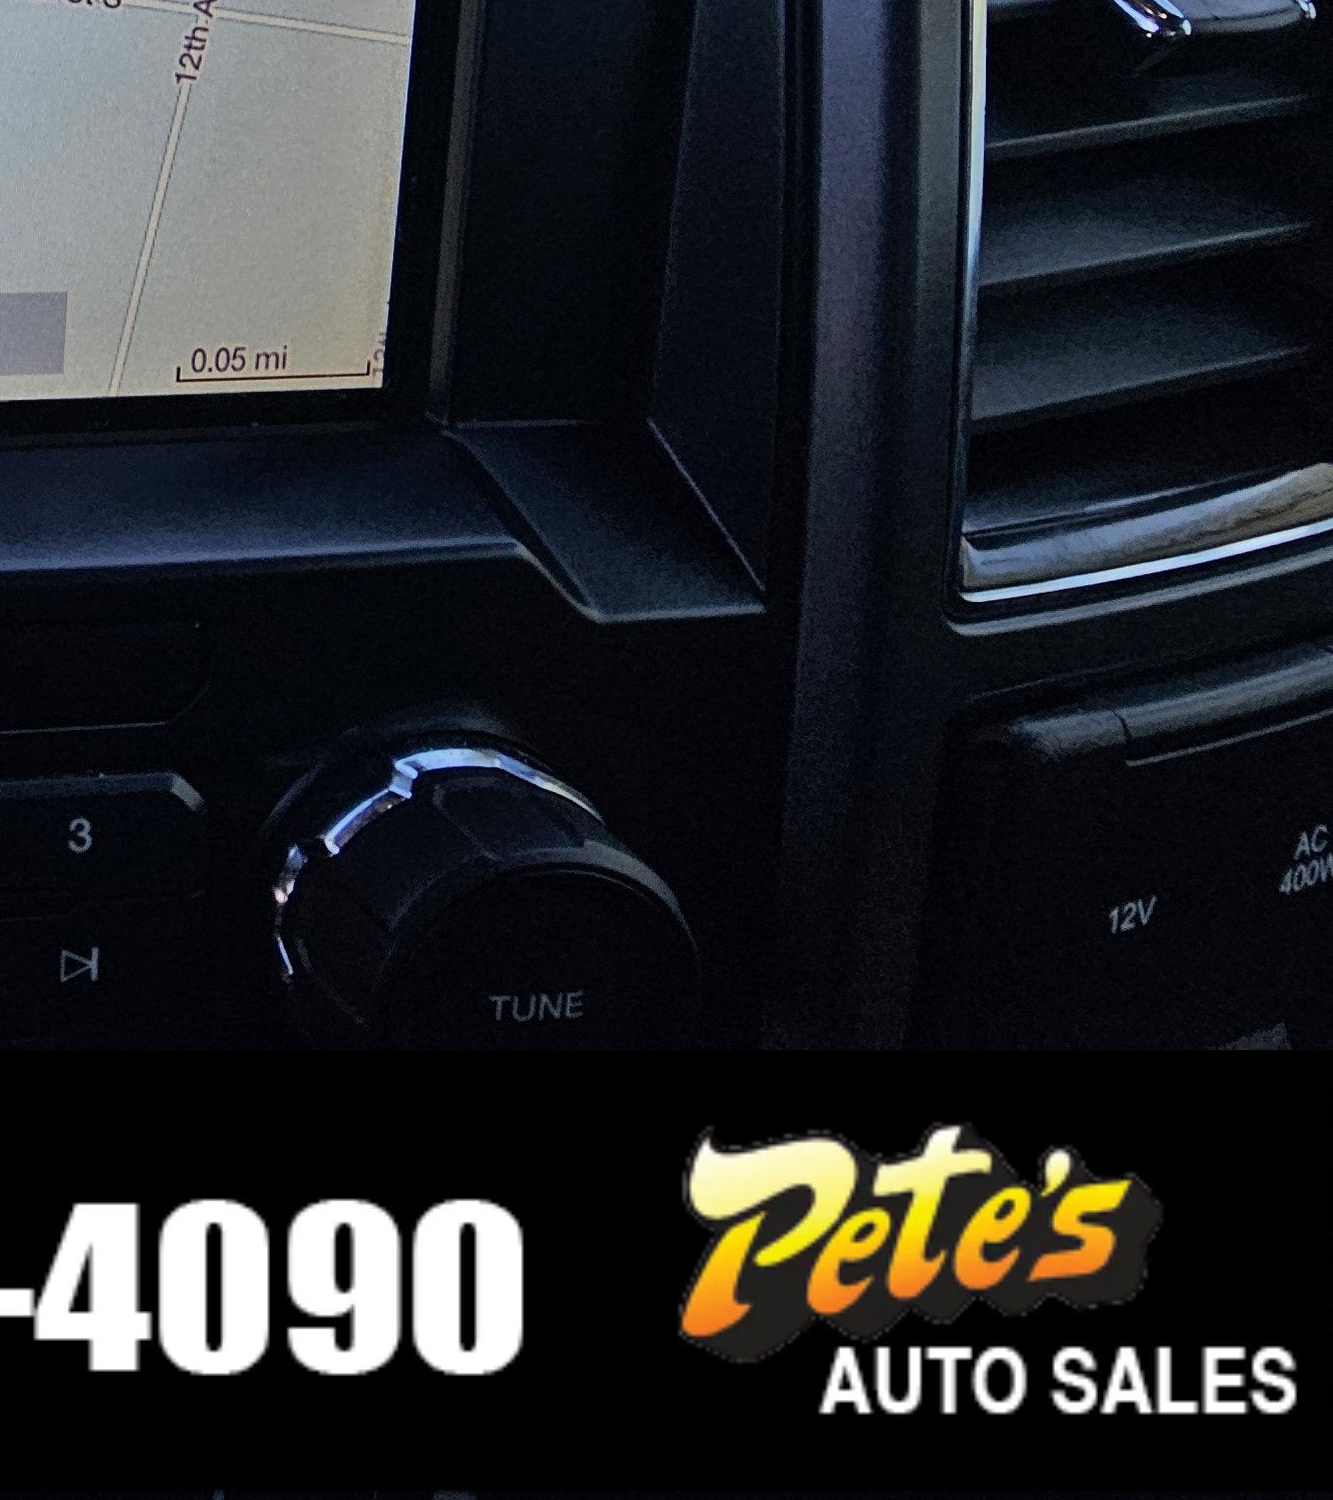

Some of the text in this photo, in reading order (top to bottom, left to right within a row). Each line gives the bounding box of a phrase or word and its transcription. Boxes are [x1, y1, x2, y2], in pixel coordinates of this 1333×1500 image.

[175, 26, 209, 84] 12th
[191, 344, 288, 373] 0.05 mi
[68, 817, 93, 854] 3
[1294, 824, 1328, 861] AC
[1108, 895, 1157, 934] 12V
[488, 990, 585, 1023] TUNE
